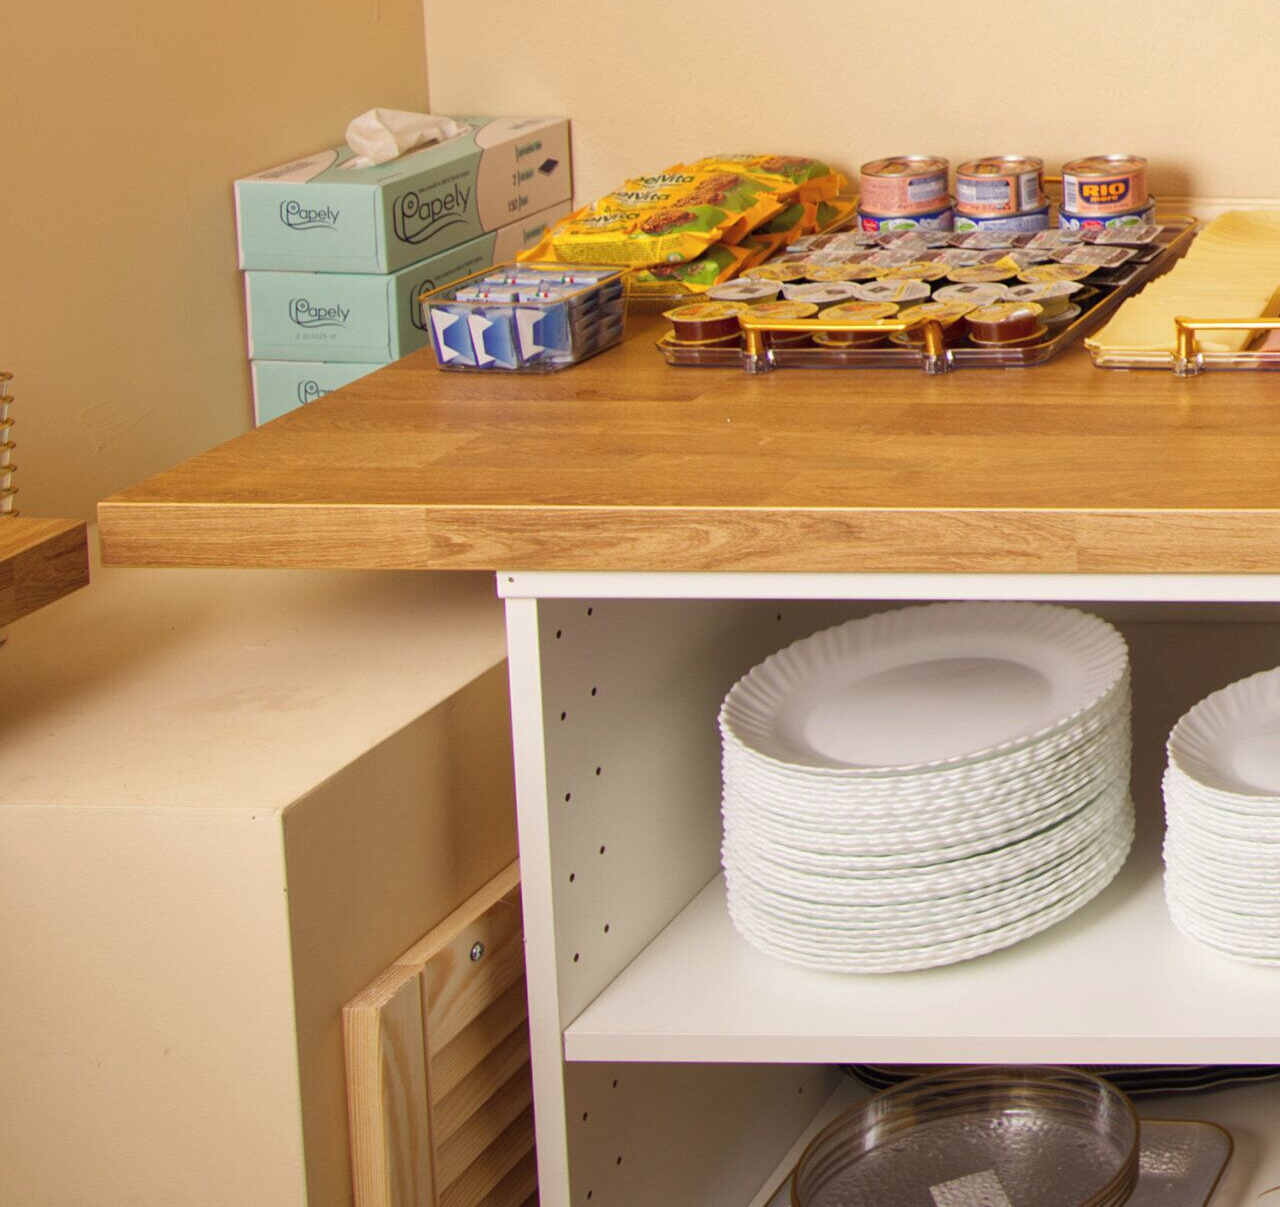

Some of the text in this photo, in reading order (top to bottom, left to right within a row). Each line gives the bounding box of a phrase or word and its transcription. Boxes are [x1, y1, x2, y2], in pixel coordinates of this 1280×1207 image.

[1082, 182, 1126, 197] RIO
[279, 199, 341, 231] Papely
[393, 184, 472, 245] Papely
[288, 297, 351, 329] Papely
